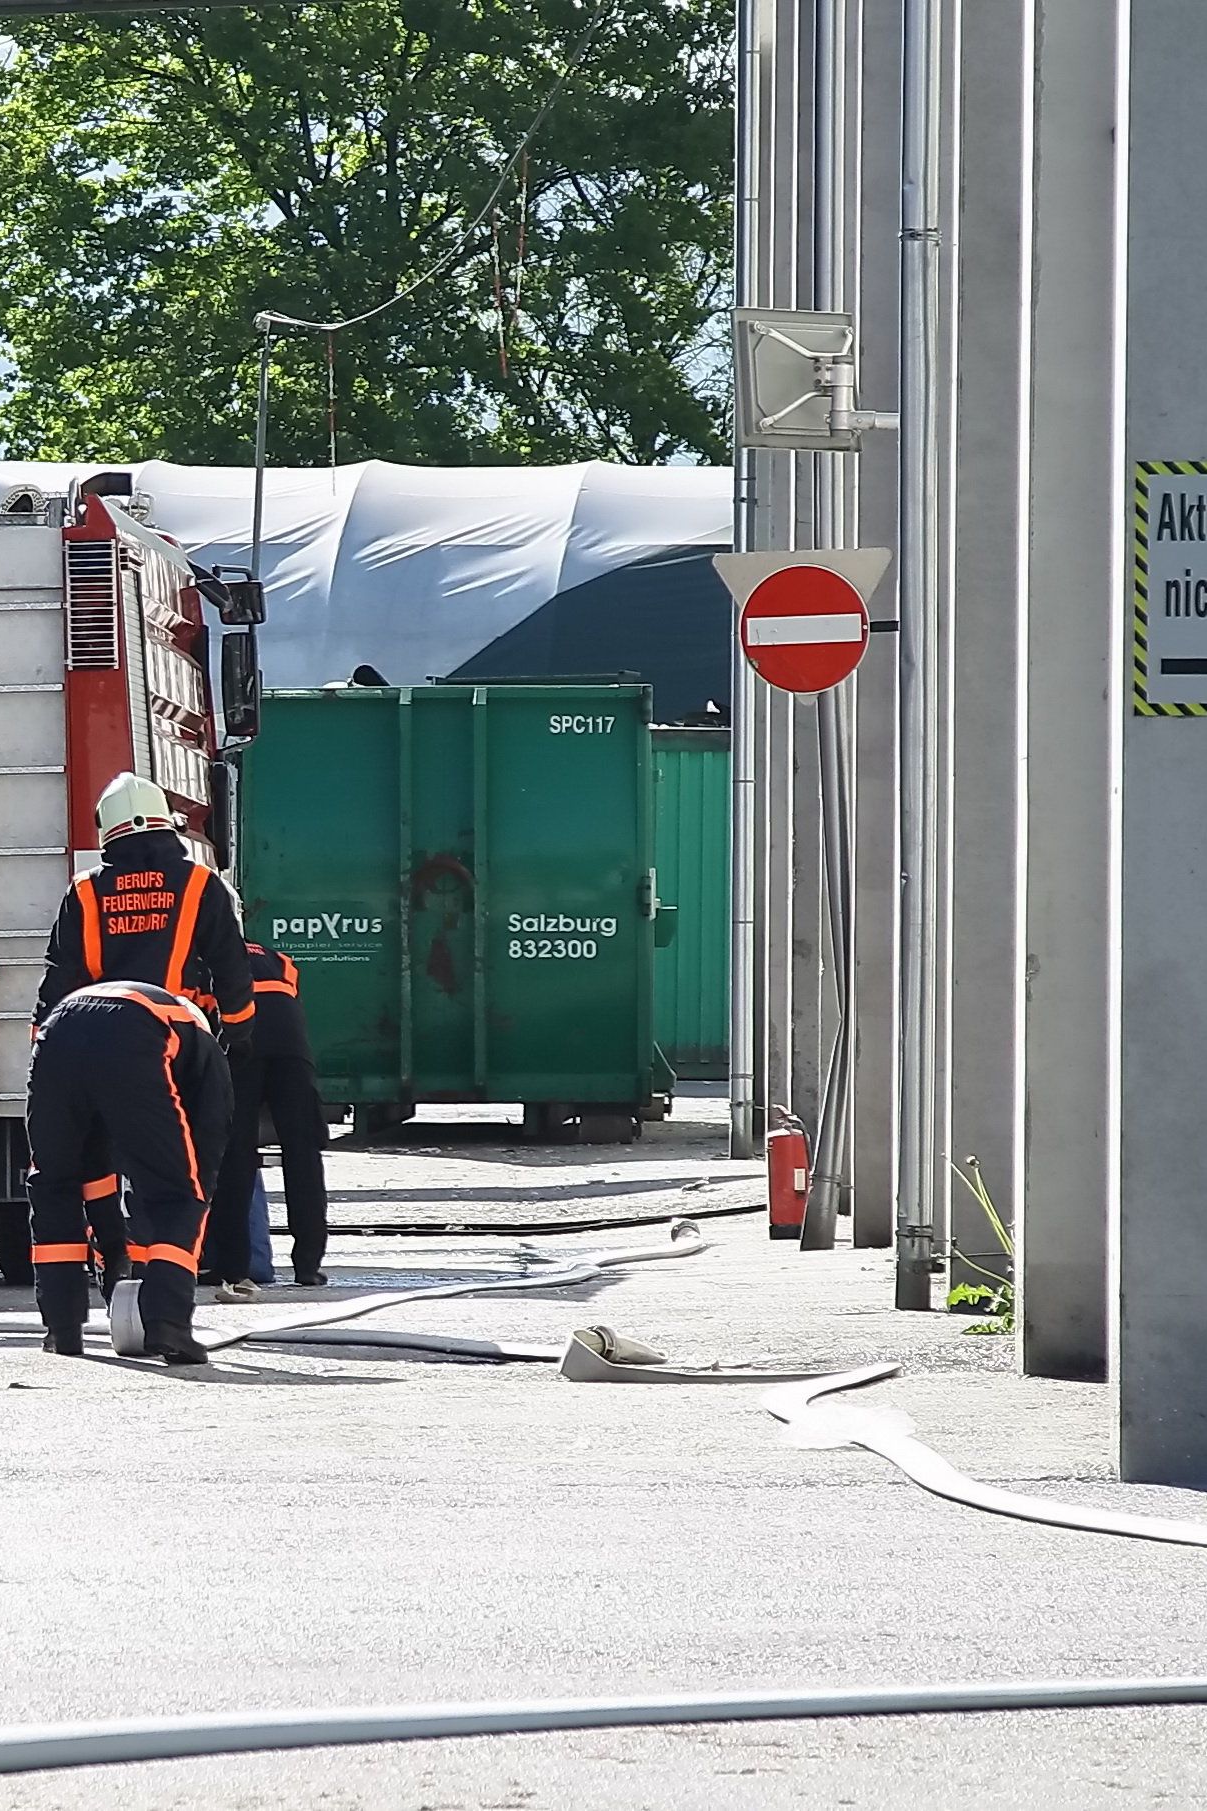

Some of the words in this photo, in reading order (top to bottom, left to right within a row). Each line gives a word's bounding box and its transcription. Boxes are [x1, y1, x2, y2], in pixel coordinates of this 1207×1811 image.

[1156, 492, 1207, 542] Akt
[549, 715, 615, 734] SPC117
[116, 871, 164, 891] BERUFS
[102, 891, 175, 913] FEUERWEHR
[108, 913, 169, 935] SALZBURG
[507, 913, 617, 937] Salzburg
[321, 954, 371, 962] solutions
[508, 939, 597, 959] 832300
